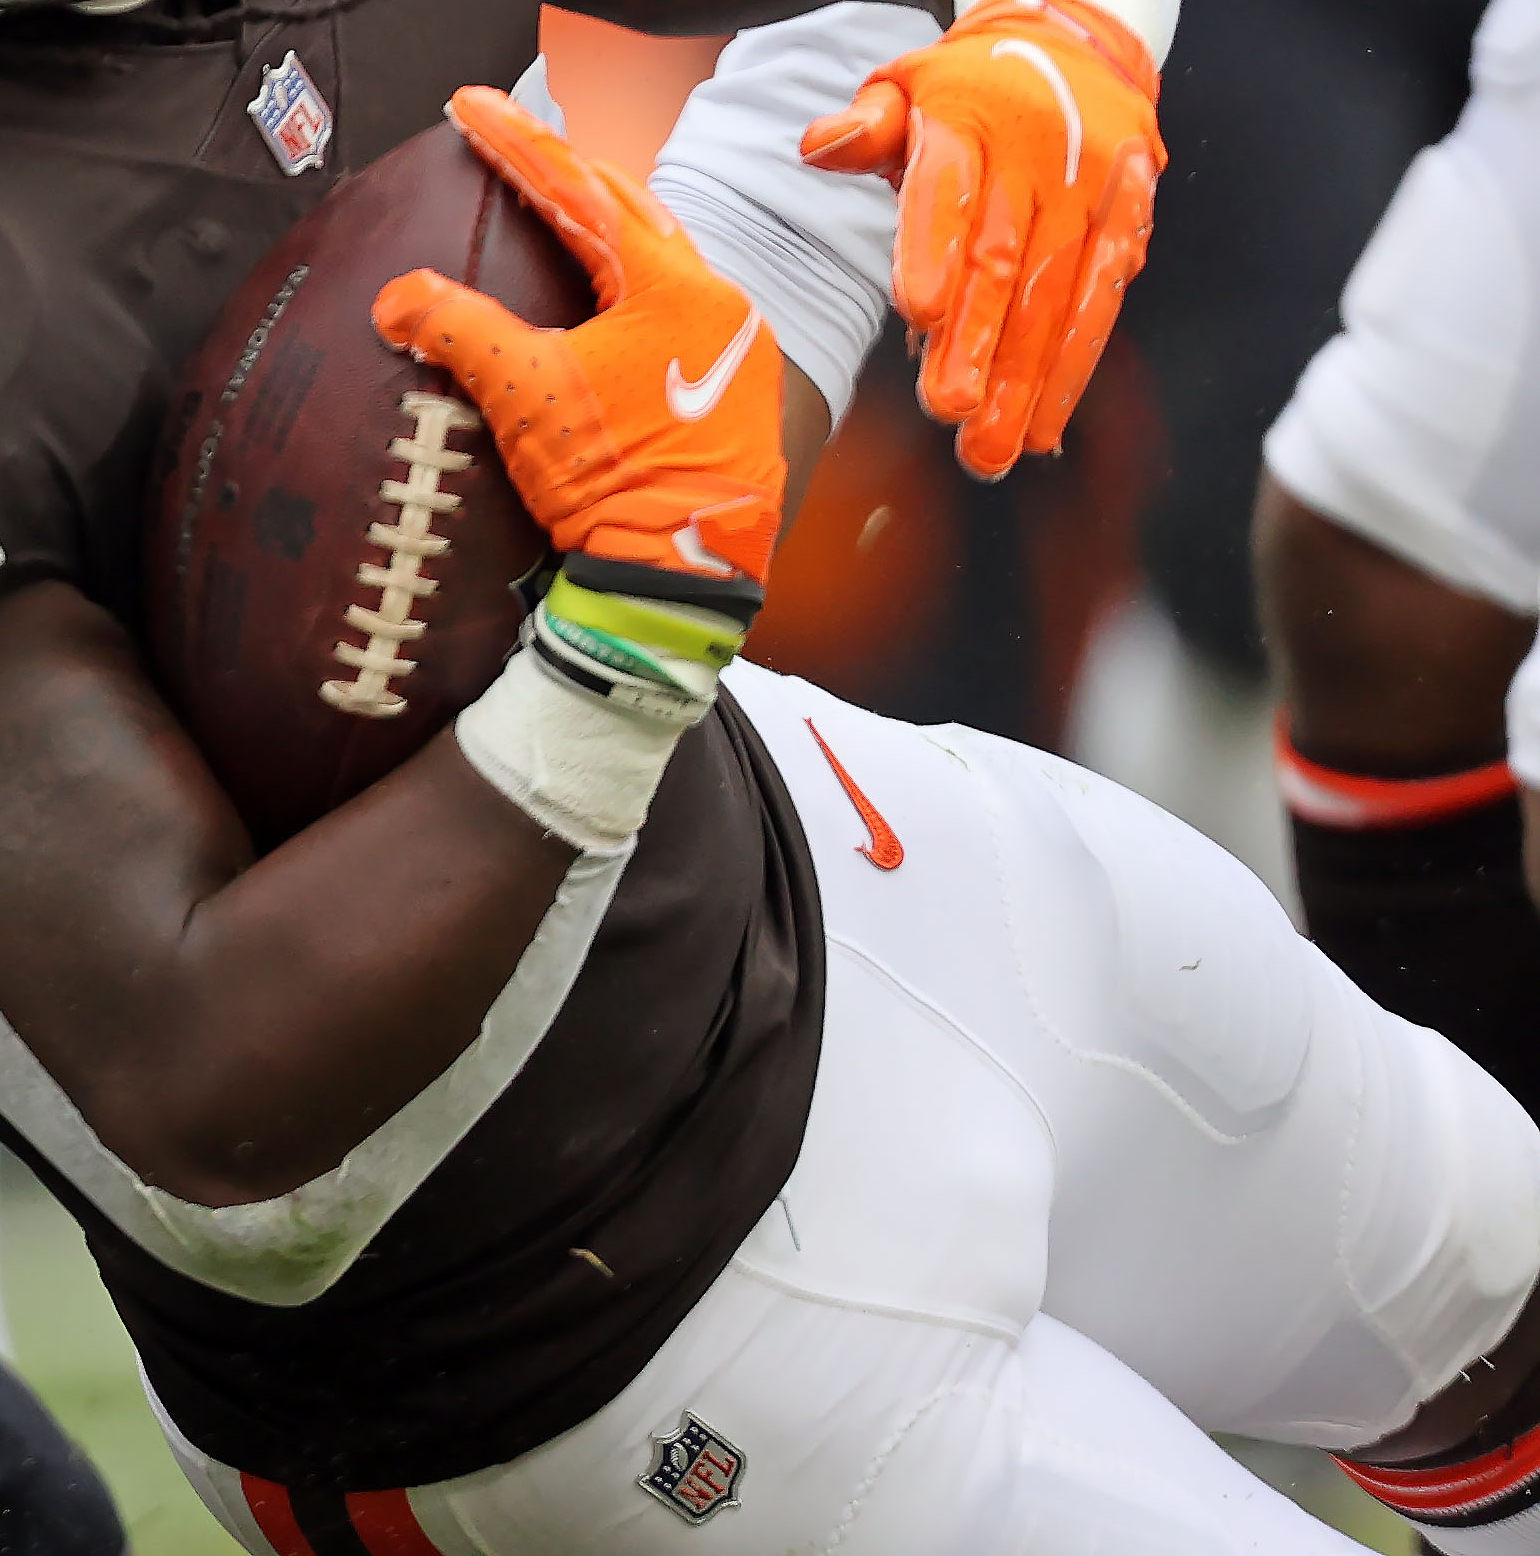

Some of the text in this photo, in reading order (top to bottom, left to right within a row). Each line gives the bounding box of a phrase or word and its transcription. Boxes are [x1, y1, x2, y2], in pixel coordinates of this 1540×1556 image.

[276, 99, 322, 161] NFL
[221, 264, 312, 402] NATIONAL
[678, 1448, 736, 1511] NFL
